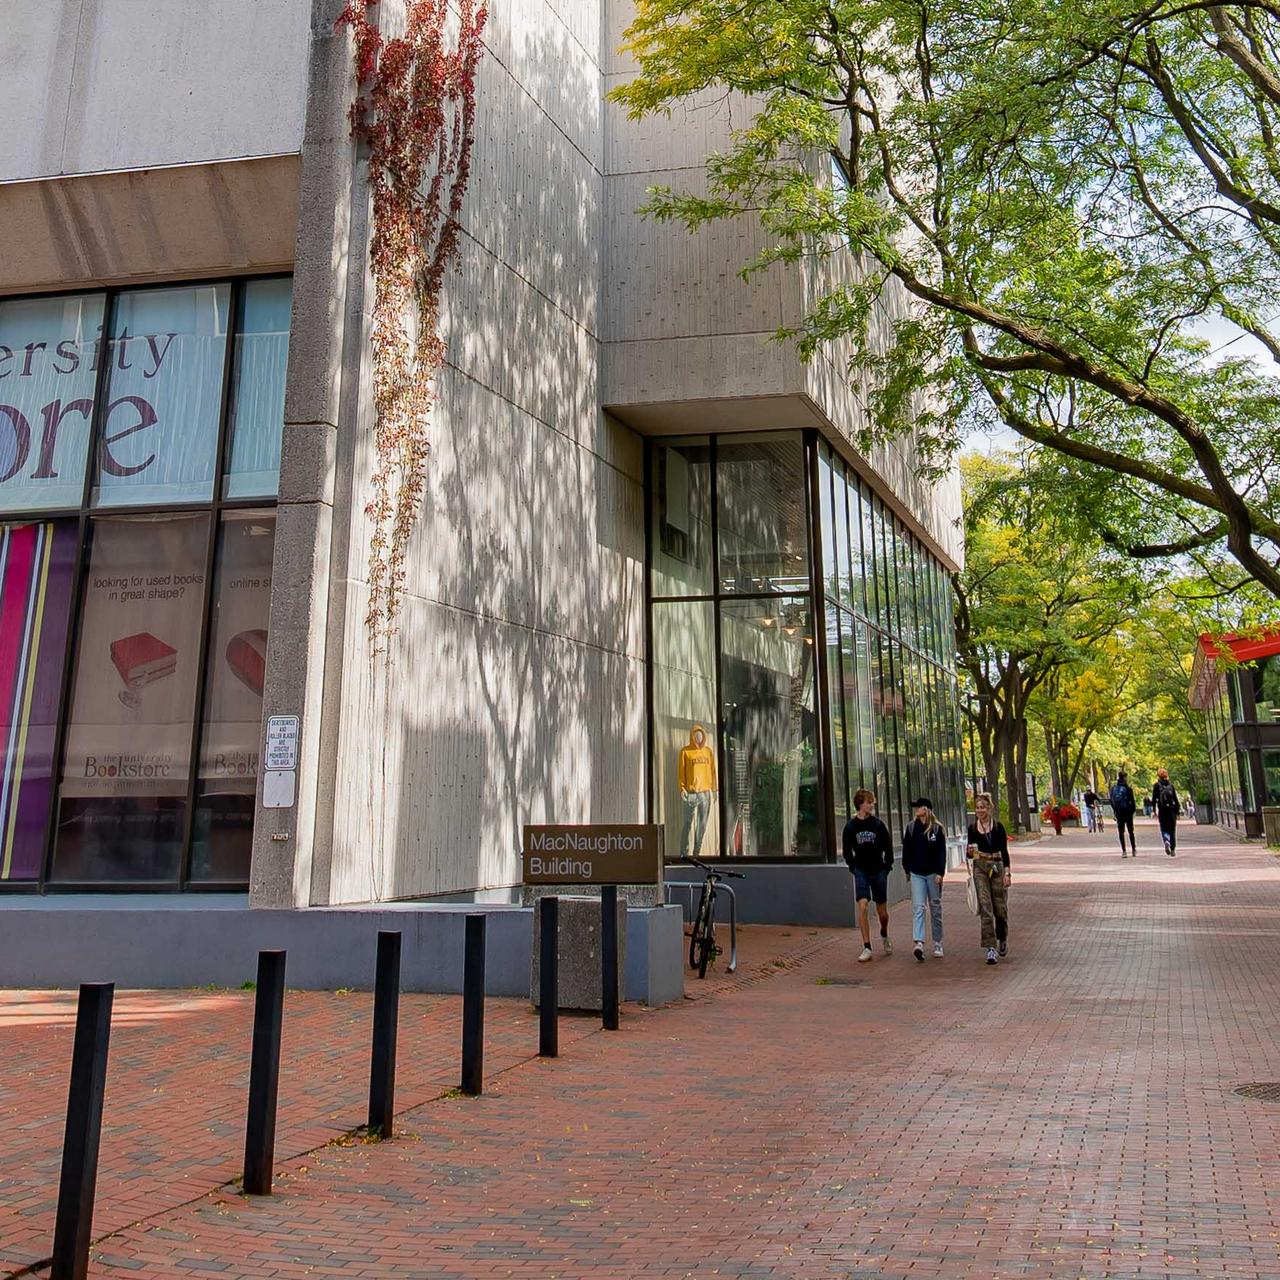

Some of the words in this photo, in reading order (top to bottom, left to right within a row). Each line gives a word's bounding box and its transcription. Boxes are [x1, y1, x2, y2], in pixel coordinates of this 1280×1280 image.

[93, 576, 128, 589] looking
[130, 575, 144, 587] for
[146, 575, 171, 587] used
[173, 574, 204, 586] books
[229, 575, 260, 588] online
[108, 588, 118, 600] in
[120, 588, 146, 603] great
[148, 587, 185, 601] shape?
[83, 756, 171, 778] Bookstore
[530, 832, 643, 854] MacNaughton
[530, 857, 592, 878] Building
